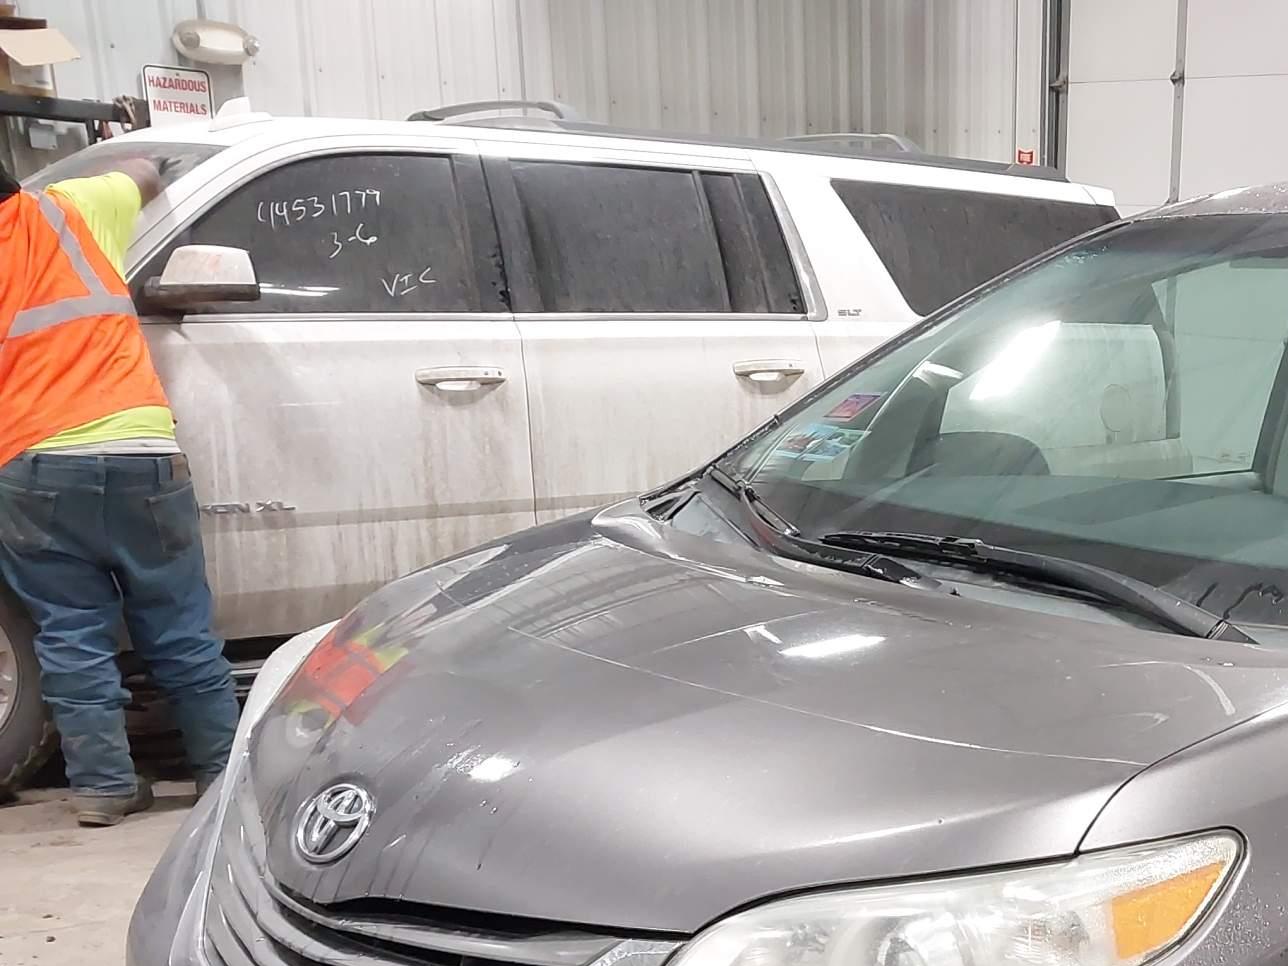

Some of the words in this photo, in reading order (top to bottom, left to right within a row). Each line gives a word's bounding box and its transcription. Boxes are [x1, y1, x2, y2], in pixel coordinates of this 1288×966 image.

[148, 75, 207, 93] HAZARDOUS
[153, 100, 207, 115] MATERIALS
[329, 223, 378, 259] 3-6
[381, 267, 436, 297] VIC
